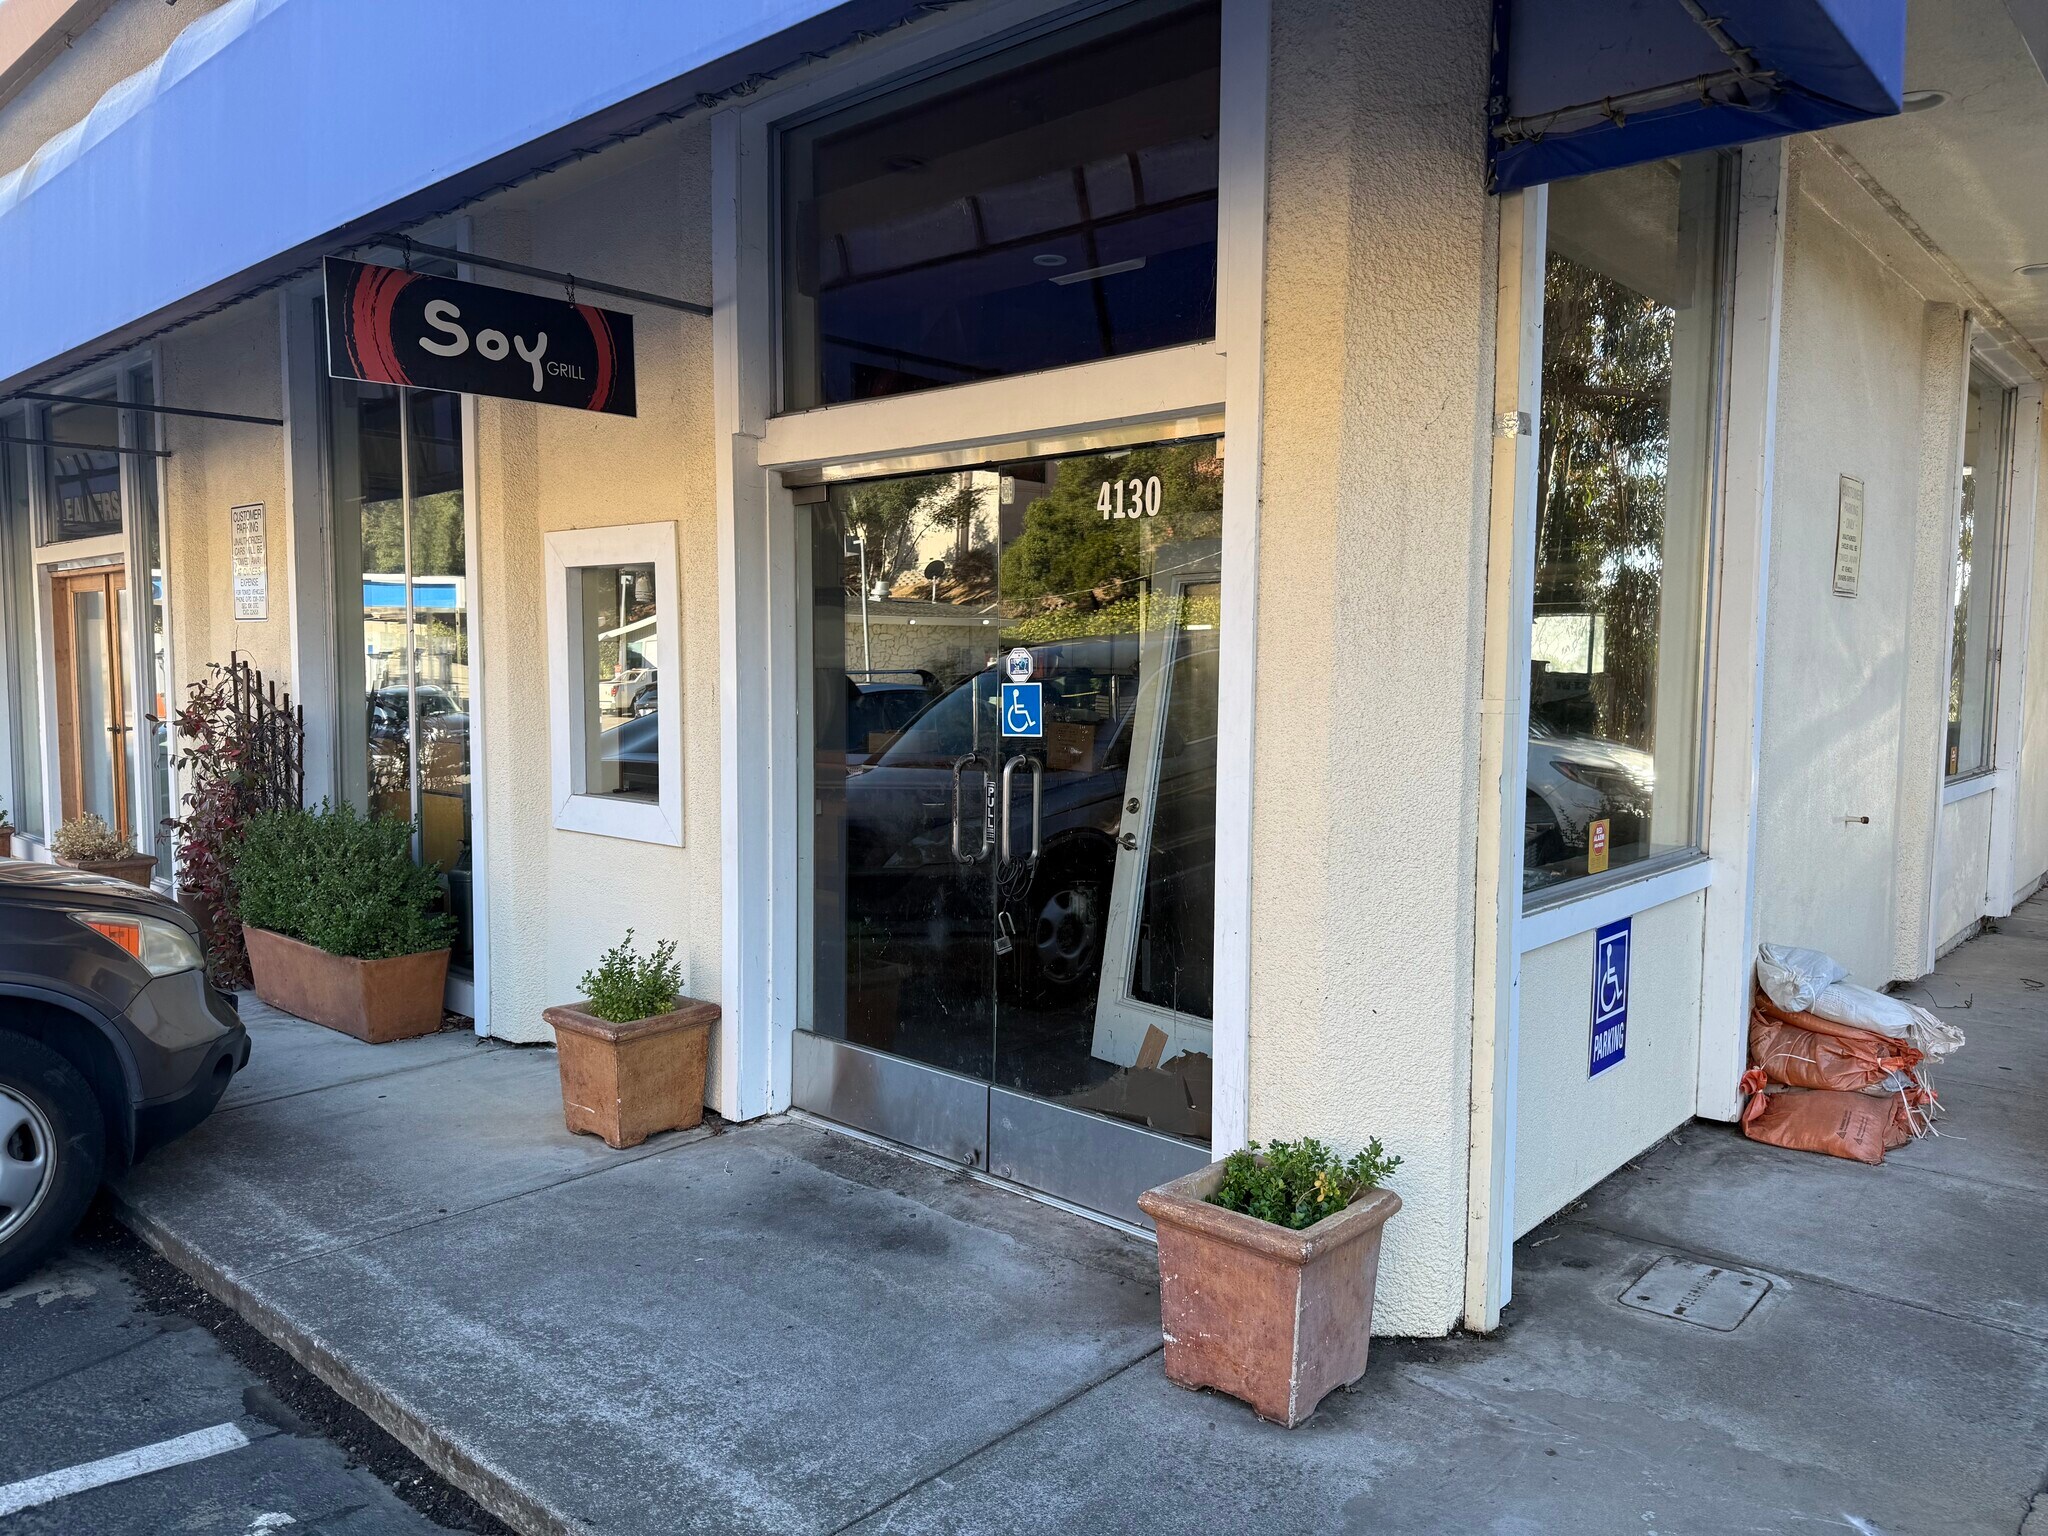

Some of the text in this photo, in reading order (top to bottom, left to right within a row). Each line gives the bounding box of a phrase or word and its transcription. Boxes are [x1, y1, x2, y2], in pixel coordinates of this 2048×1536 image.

[419, 300, 586, 392] Soy GRILL
[233, 508, 262, 522] CUSTOMER
[1097, 476, 1161, 520] 4130
[234, 546, 246, 556] CARS
[256, 544, 263, 554] BE
[240, 577, 259, 587] EXPENSE
[987, 786, 995, 828] PULL
[1593, 1021, 1624, 1063] PARKING
